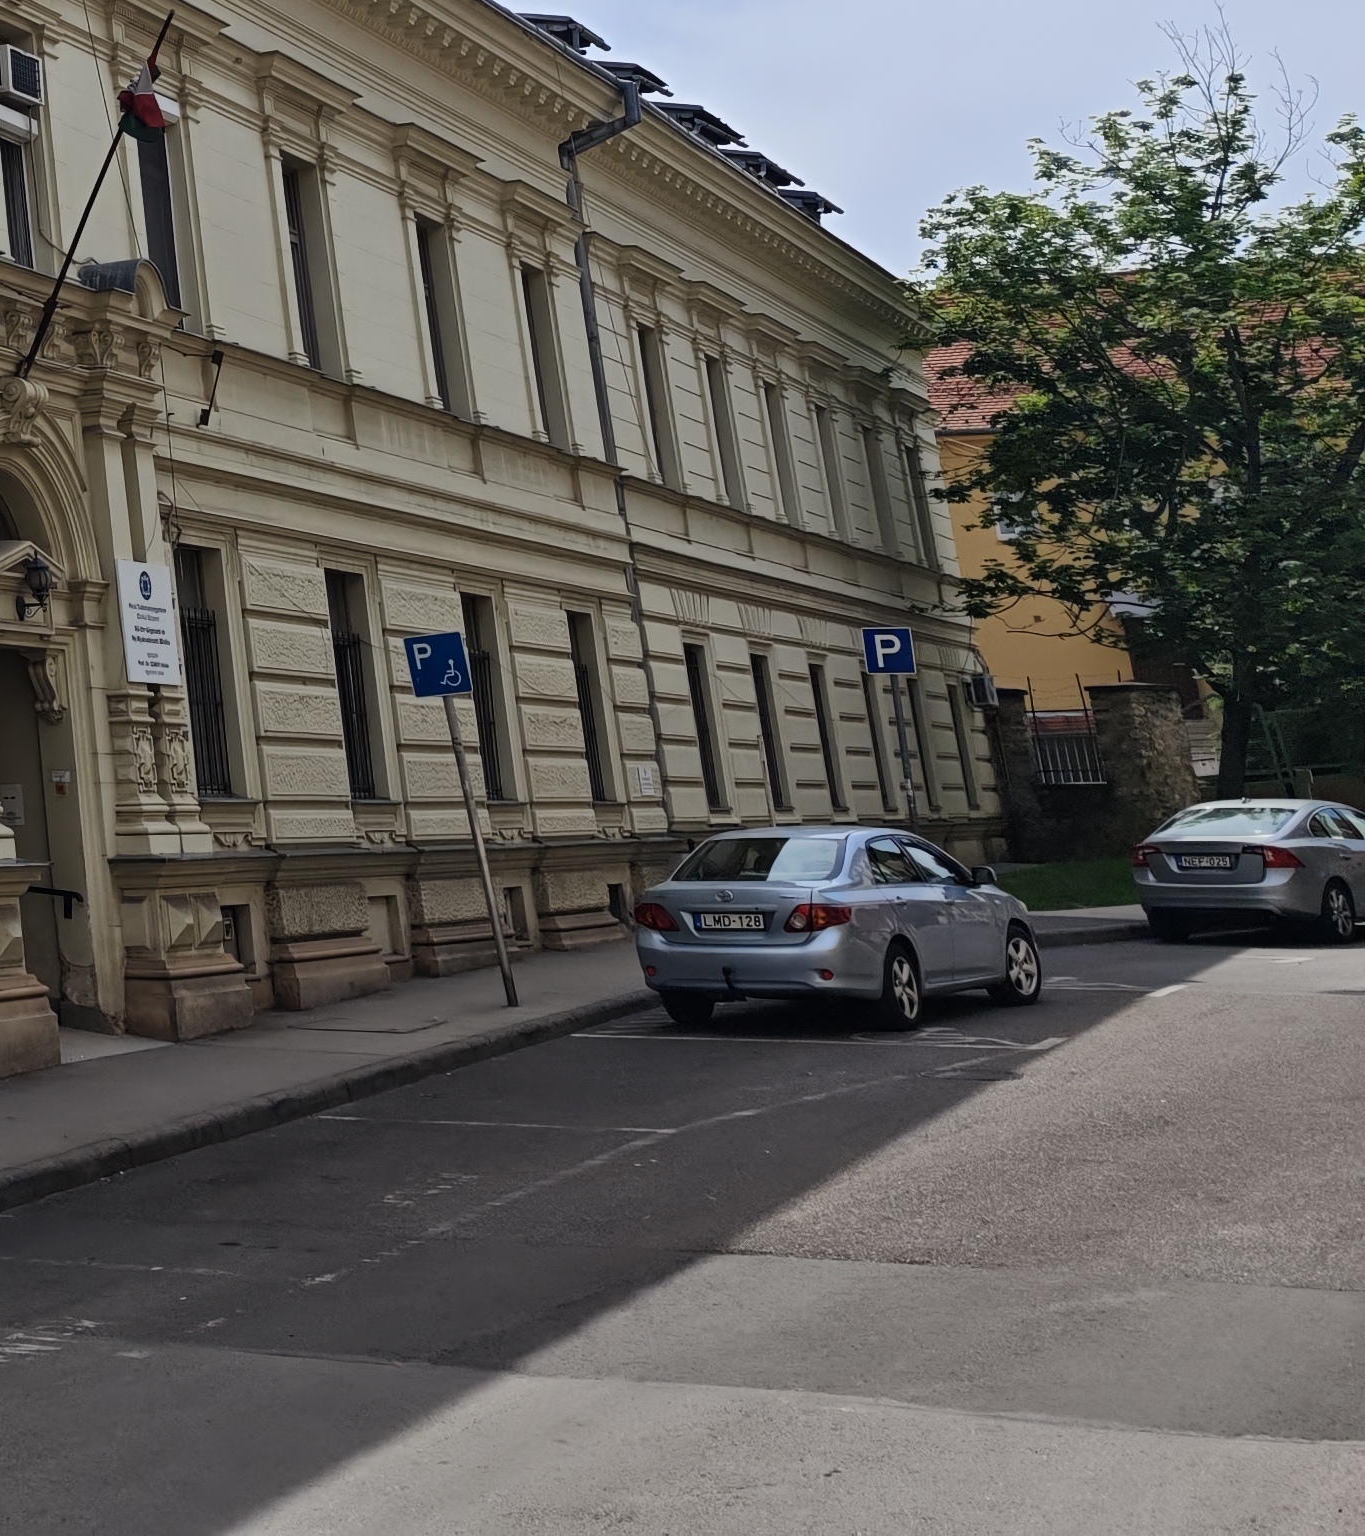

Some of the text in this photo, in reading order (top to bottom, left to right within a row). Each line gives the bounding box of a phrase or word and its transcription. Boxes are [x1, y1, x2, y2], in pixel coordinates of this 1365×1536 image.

[412, 643, 432, 670] P
[874, 634, 901, 668] P
[703, 915, 761, 927] LMD-128
